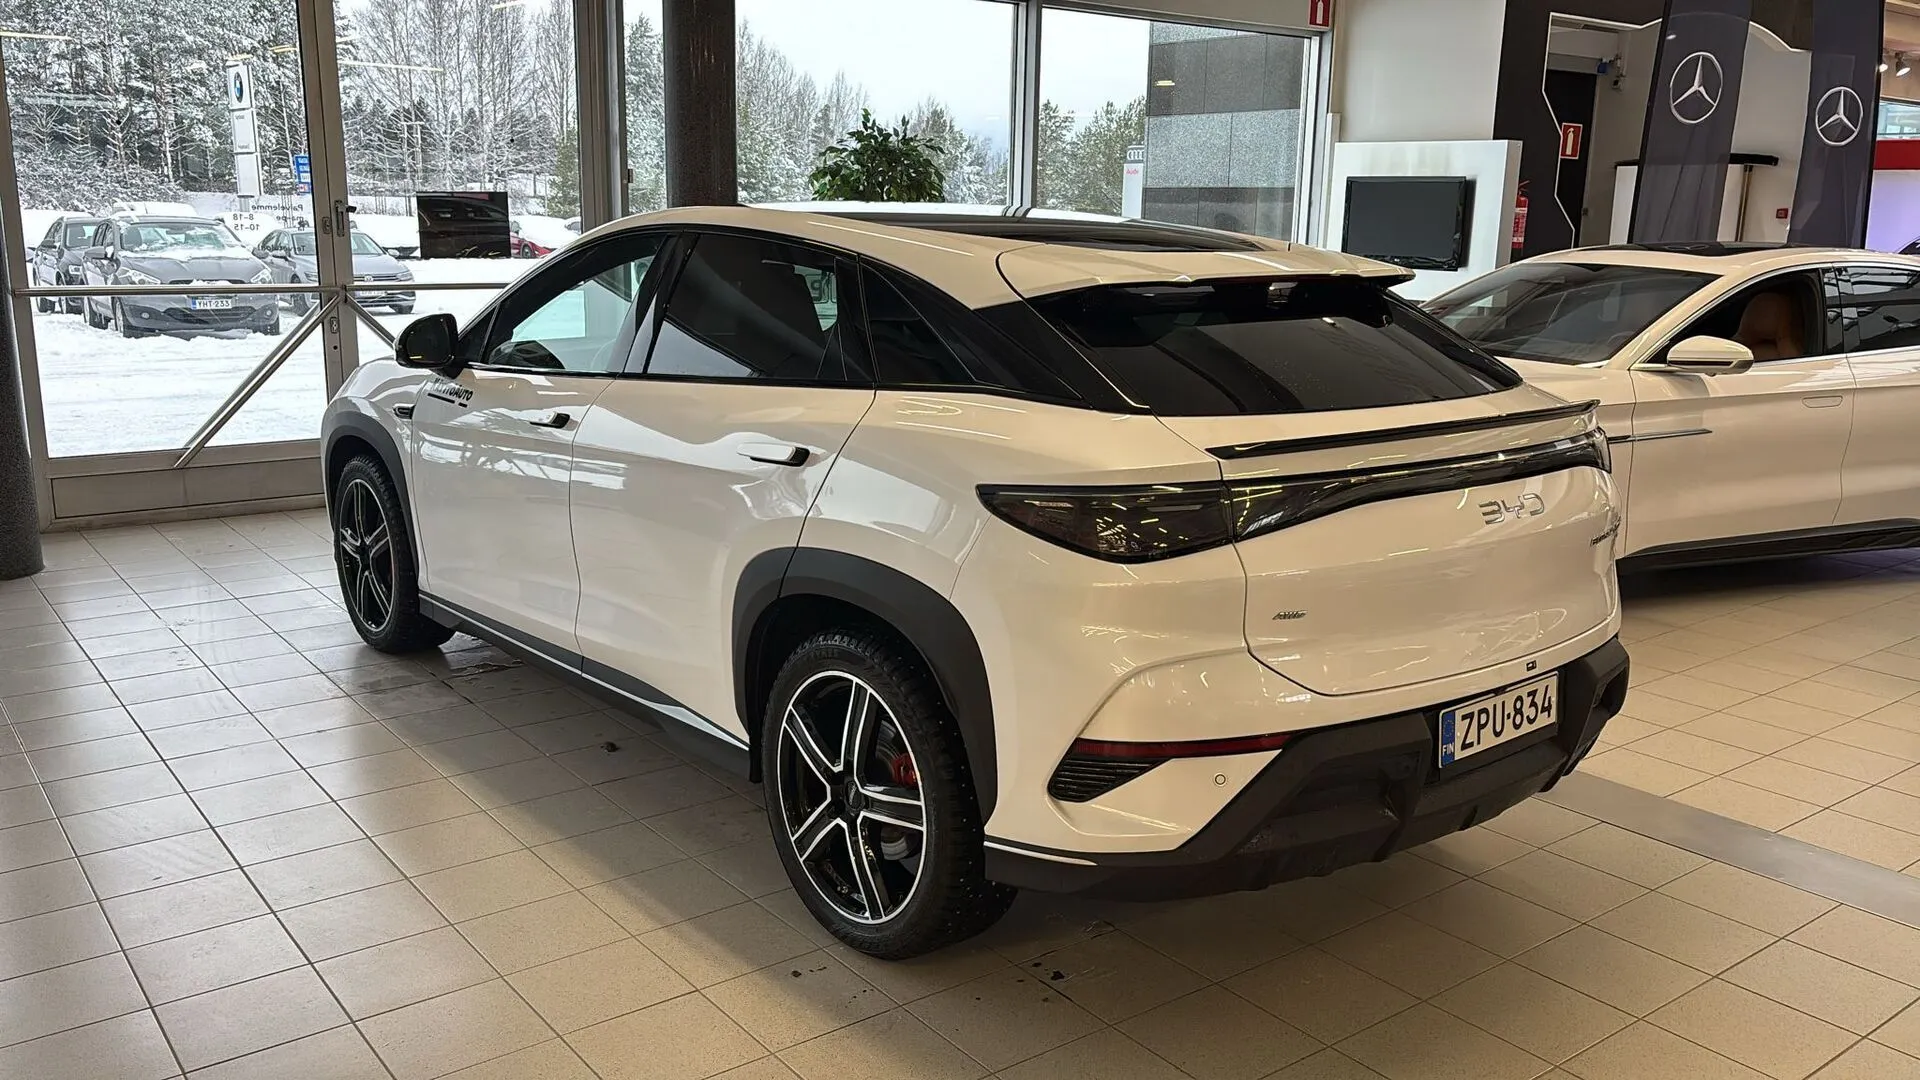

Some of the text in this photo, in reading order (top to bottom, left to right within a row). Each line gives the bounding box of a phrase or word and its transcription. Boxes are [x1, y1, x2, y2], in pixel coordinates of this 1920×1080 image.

[430, 377, 474, 402] KTTÖAUTO
[1478, 493, 1545, 525] BYD
[1442, 684, 1553, 756] FIN ZPU-834
